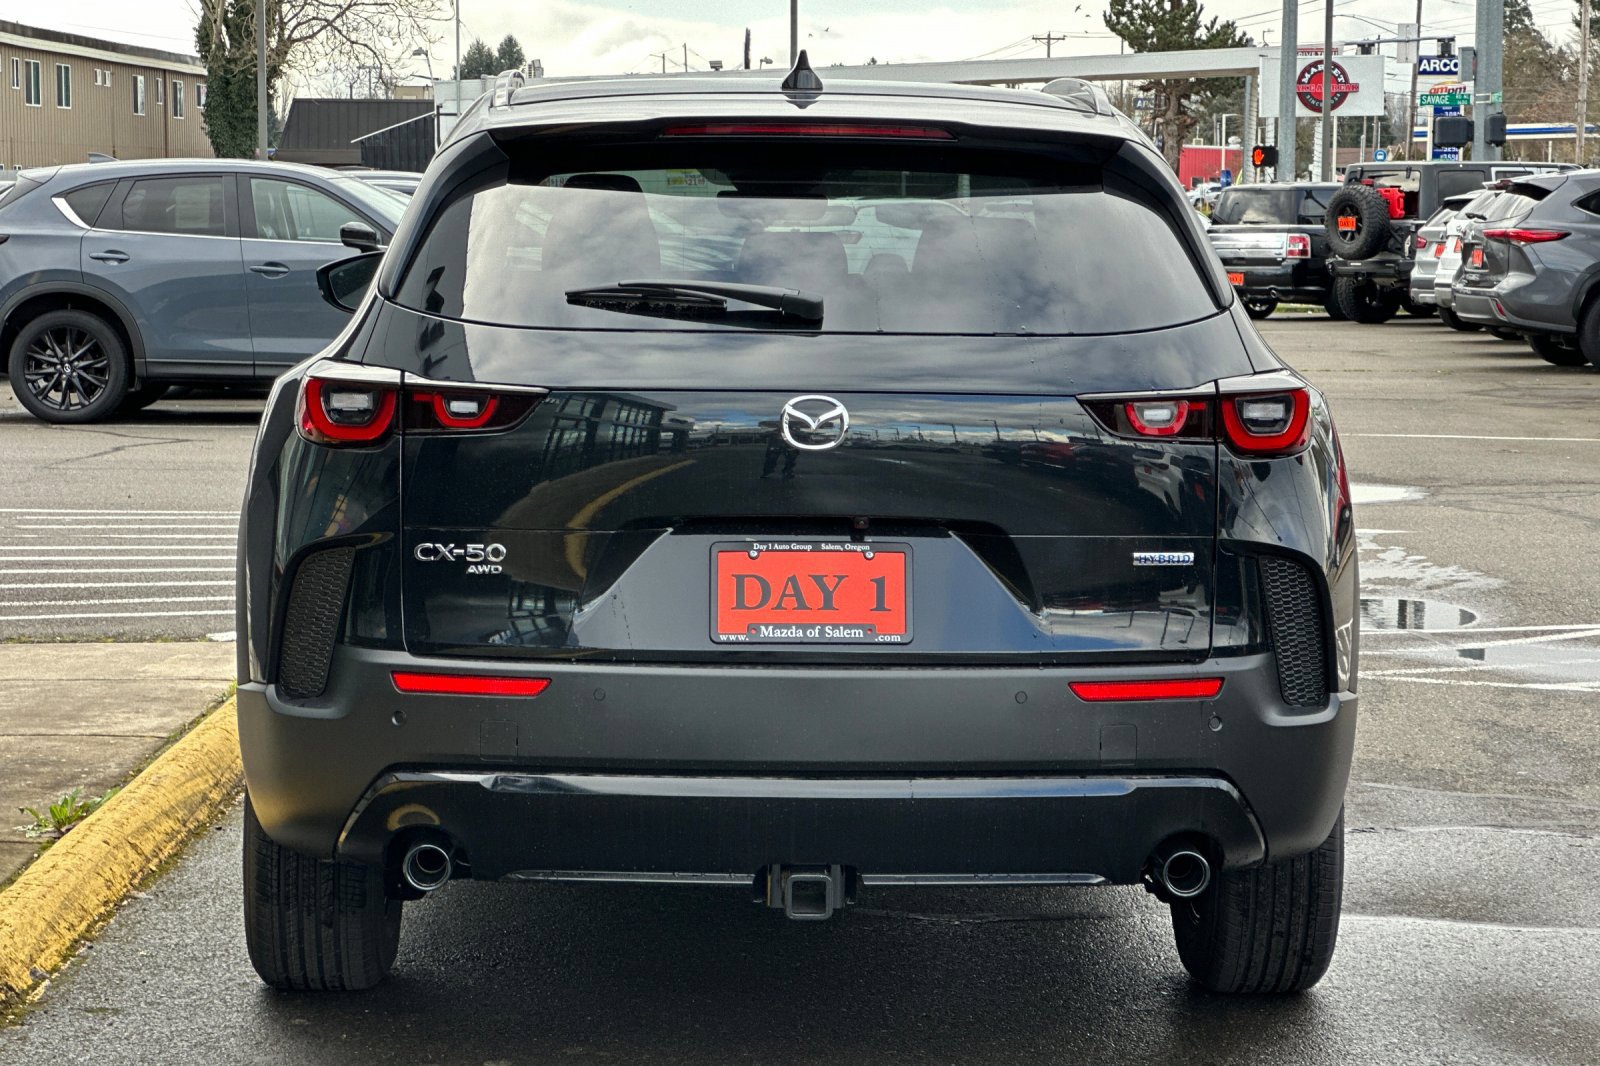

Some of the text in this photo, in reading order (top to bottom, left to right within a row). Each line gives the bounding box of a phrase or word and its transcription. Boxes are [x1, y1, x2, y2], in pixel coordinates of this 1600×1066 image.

[1419, 59, 1459, 72] ARCO
[1301, 64, 1346, 84] MARET
[1421, 95, 1450, 105] SAVAGE
[413, 542, 507, 562] CX-50
[753, 543, 768, 551] Day
[791, 543, 812, 552] Group
[821, 543, 870, 552] Salem, Oregon
[1136, 554, 1192, 564] HYBRID
[466, 564, 503, 575] AWD
[730, 573, 892, 612] DAY 1
[719, 625, 901, 642] www. Mazda of Salem .com
